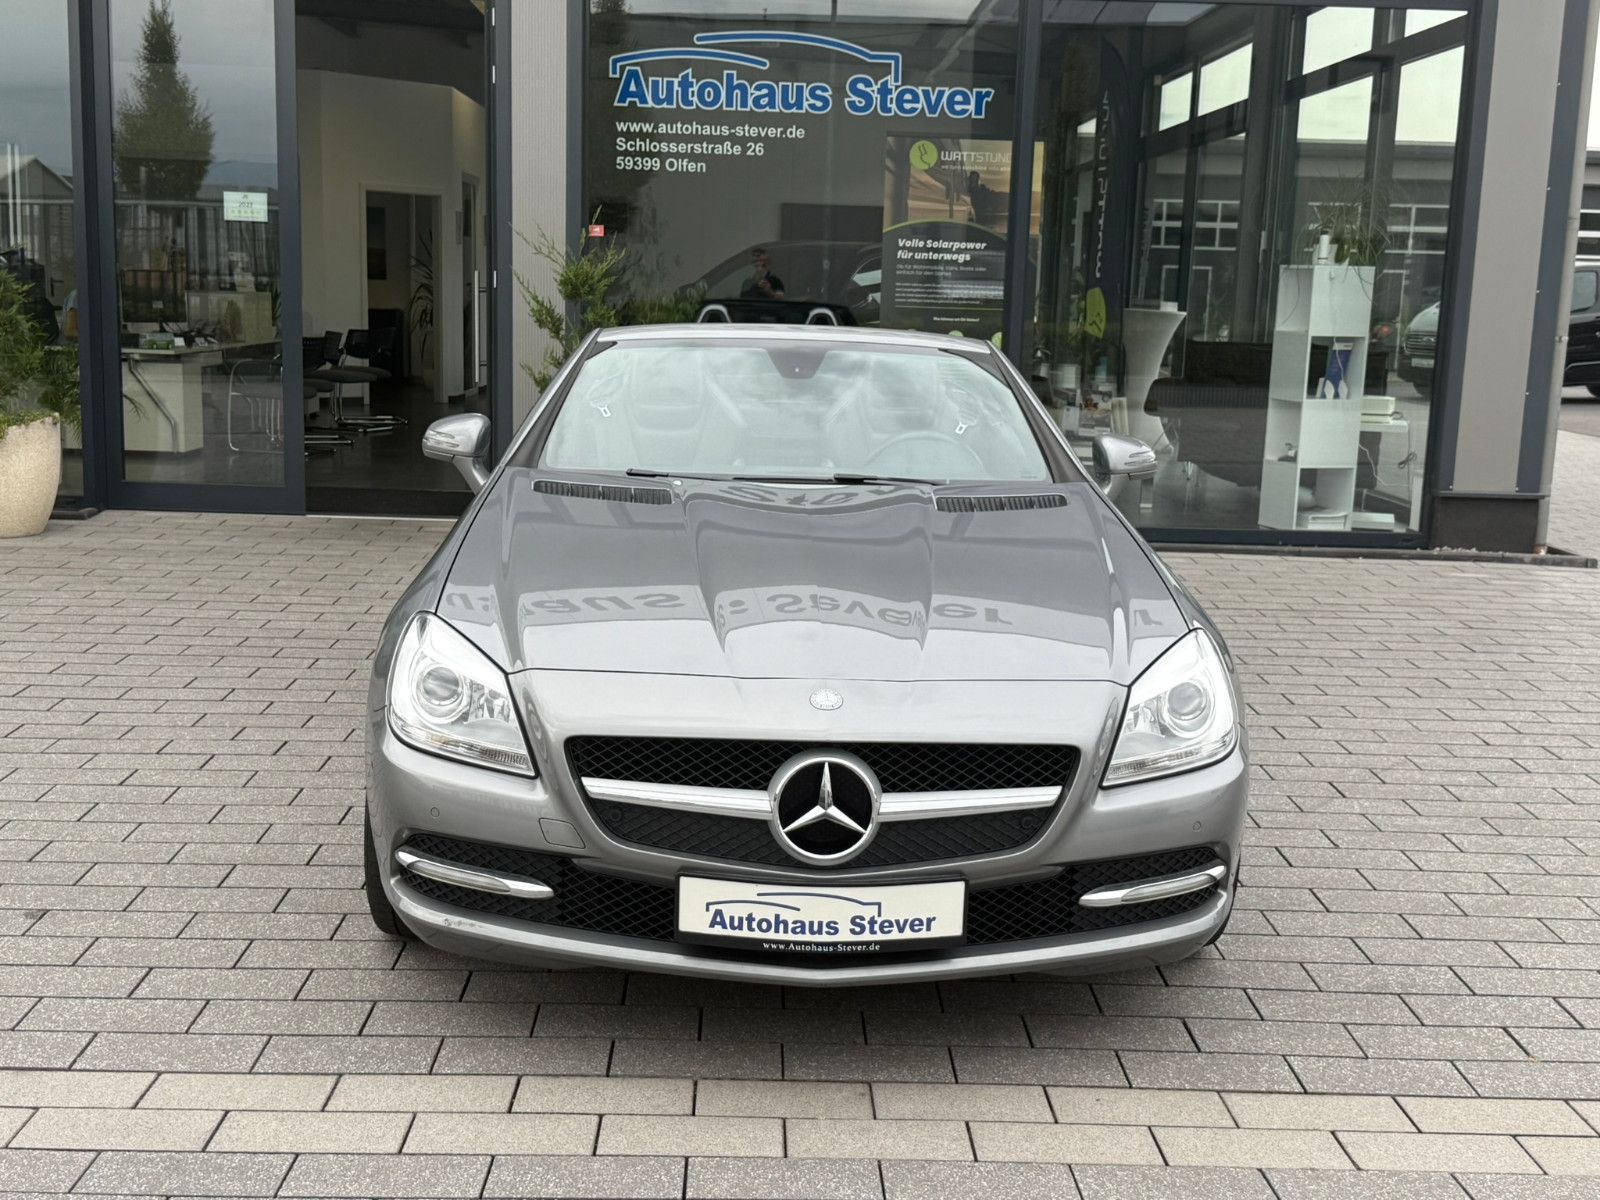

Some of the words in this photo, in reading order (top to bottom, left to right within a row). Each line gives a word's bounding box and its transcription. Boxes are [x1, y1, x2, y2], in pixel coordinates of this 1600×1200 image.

[614, 65, 832, 114] Autohaus
[845, 74, 994, 119] Stever
[615, 121, 805, 139] www.autohaus-stever.de
[615, 137, 742, 155] Schlosserstraße
[746, 142, 765, 156] 26
[615, 156, 661, 171] 59399
[665, 158, 707, 173] Olfen
[898, 238, 926, 249] Volle
[926, 239, 987, 252] Solarpower
[897, 249, 914, 260] für
[914, 252, 971, 263] unterwegs
[708, 908, 840, 936] Autohaus
[849, 914, 937, 936] Stever
[762, 940, 881, 952] www.Autohaus-Stever.de
